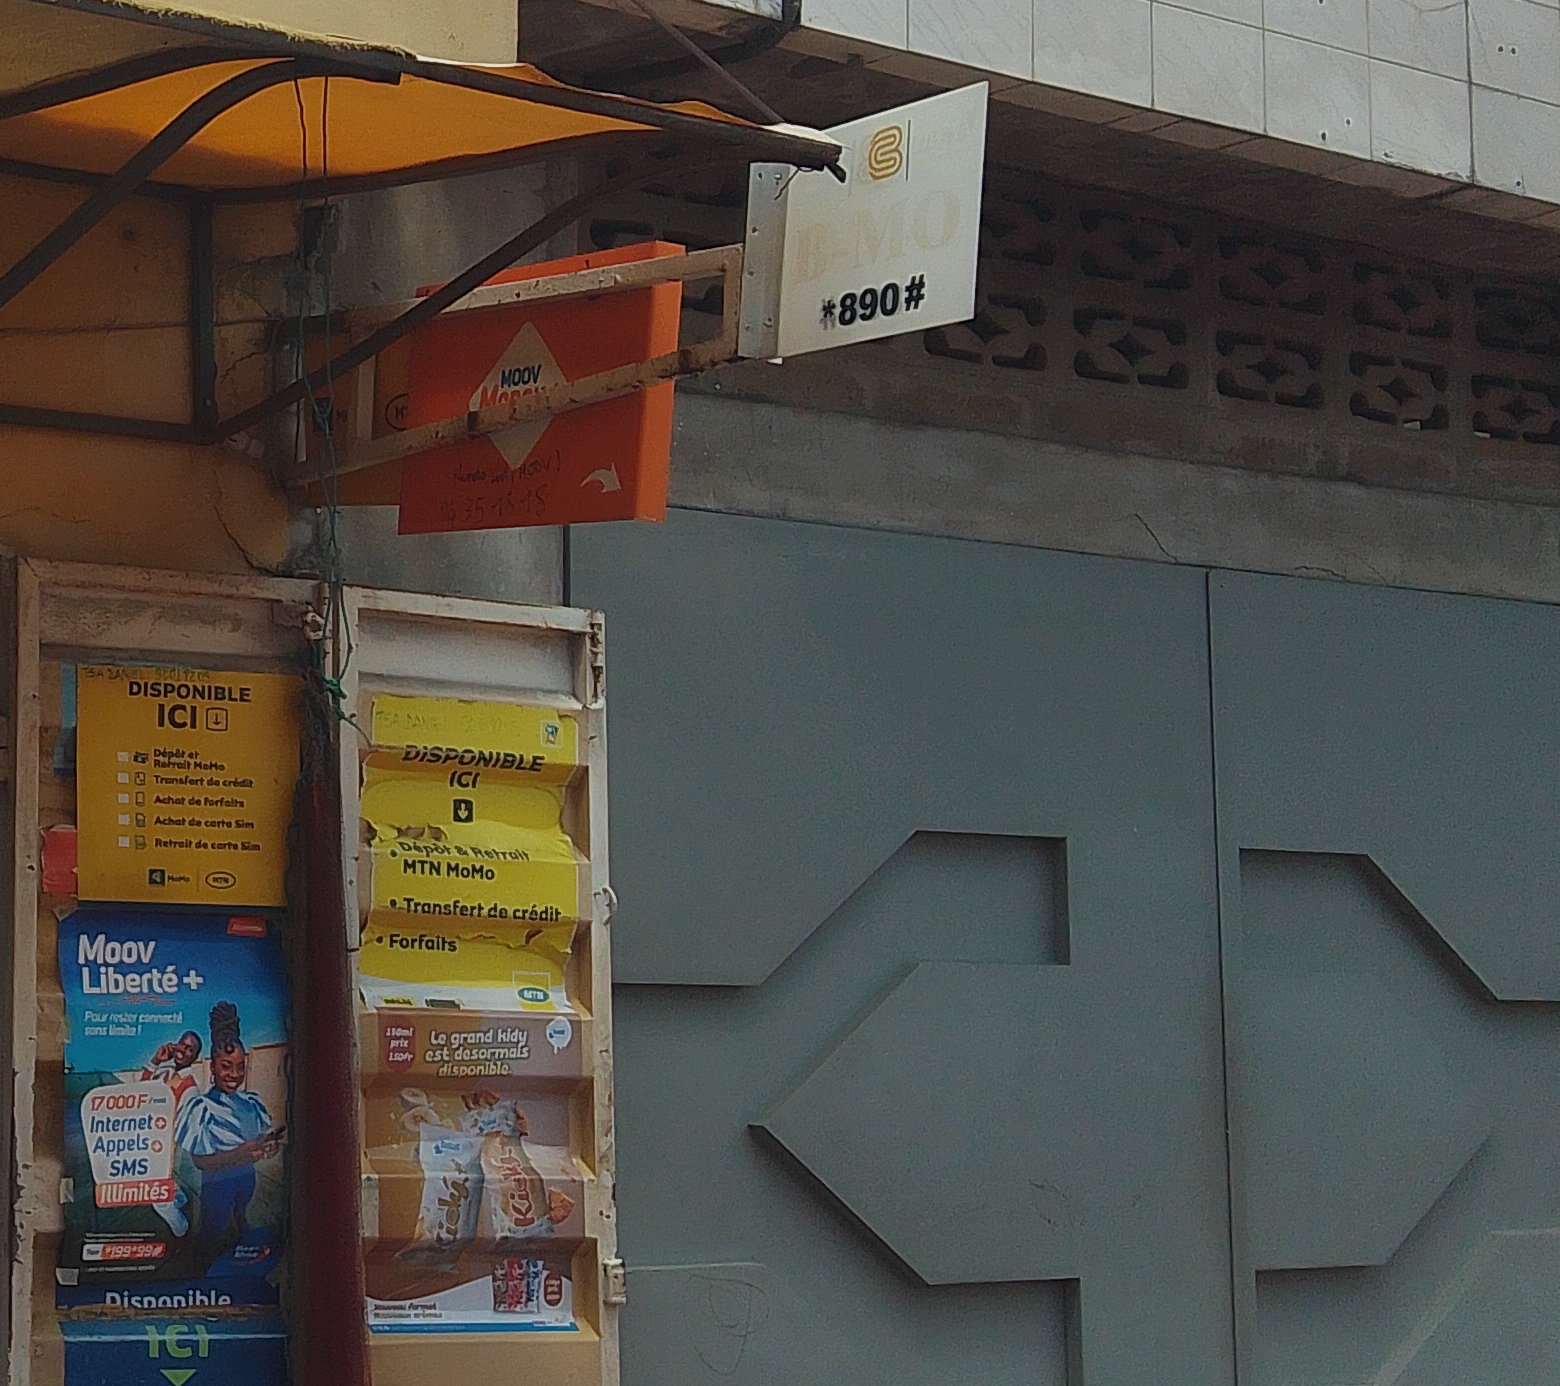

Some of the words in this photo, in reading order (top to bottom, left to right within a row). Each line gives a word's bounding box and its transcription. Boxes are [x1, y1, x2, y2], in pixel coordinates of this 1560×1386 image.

[500, 364, 542, 388] MOOV
[128, 681, 252, 703] DISPONIBLE
[157, 703, 197, 729] ICI
[402, 745, 545, 772] DISPONIBLE
[153, 775, 204, 787] Transfert
[206, 777, 220, 787] de
[222, 777, 254, 789] crédit
[449, 770, 480, 789] ICI
[153, 795, 186, 805] Achat
[188, 797, 201, 806] de
[154, 816, 186, 826] Achat
[188, 818, 202, 827] de
[204, 819, 232, 828] carte
[234, 819, 254, 829] Sim
[154, 838, 192, 849] Retrait
[194, 840, 208, 849] de
[210, 842, 238, 851] carte
[240, 842, 260, 851] Sim
[398, 842, 451, 857] Dépôt
[470, 846, 530, 861] Retrait
[403, 859, 441, 876] MTN
[446, 862, 495, 881] MoMo
[403, 897, 485, 918] Transfert
[487, 903, 508, 919] de
[512, 903, 562, 922] crédit
[77, 933, 157, 965] Moov
[389, 933, 458, 952] Forfaits
[82, 965, 179, 994] Liberté
[183, 969, 204, 990] +
[84, 1010, 108, 1023] Pour
[109, 1011, 138, 1024] rester
[138, 1010, 183, 1024] connecté
[84, 1026, 108, 1037] sans
[430, 1030, 447, 1045] Le
[450, 1029, 493, 1049] grand
[496, 1027, 528, 1047] kidy
[389, 1039, 409, 1049] prix
[424, 1047, 450, 1062] est
[453, 1044, 530, 1062] desormais
[90, 1114, 154, 1134] Internet
[93, 1136, 150, 1157] Appels
[108, 1158, 149, 1177] SMS
[100, 1183, 169, 1204] Illimités
[105, 1290, 232, 1309] Disponible
[145, 1324, 209, 1359] ICI
